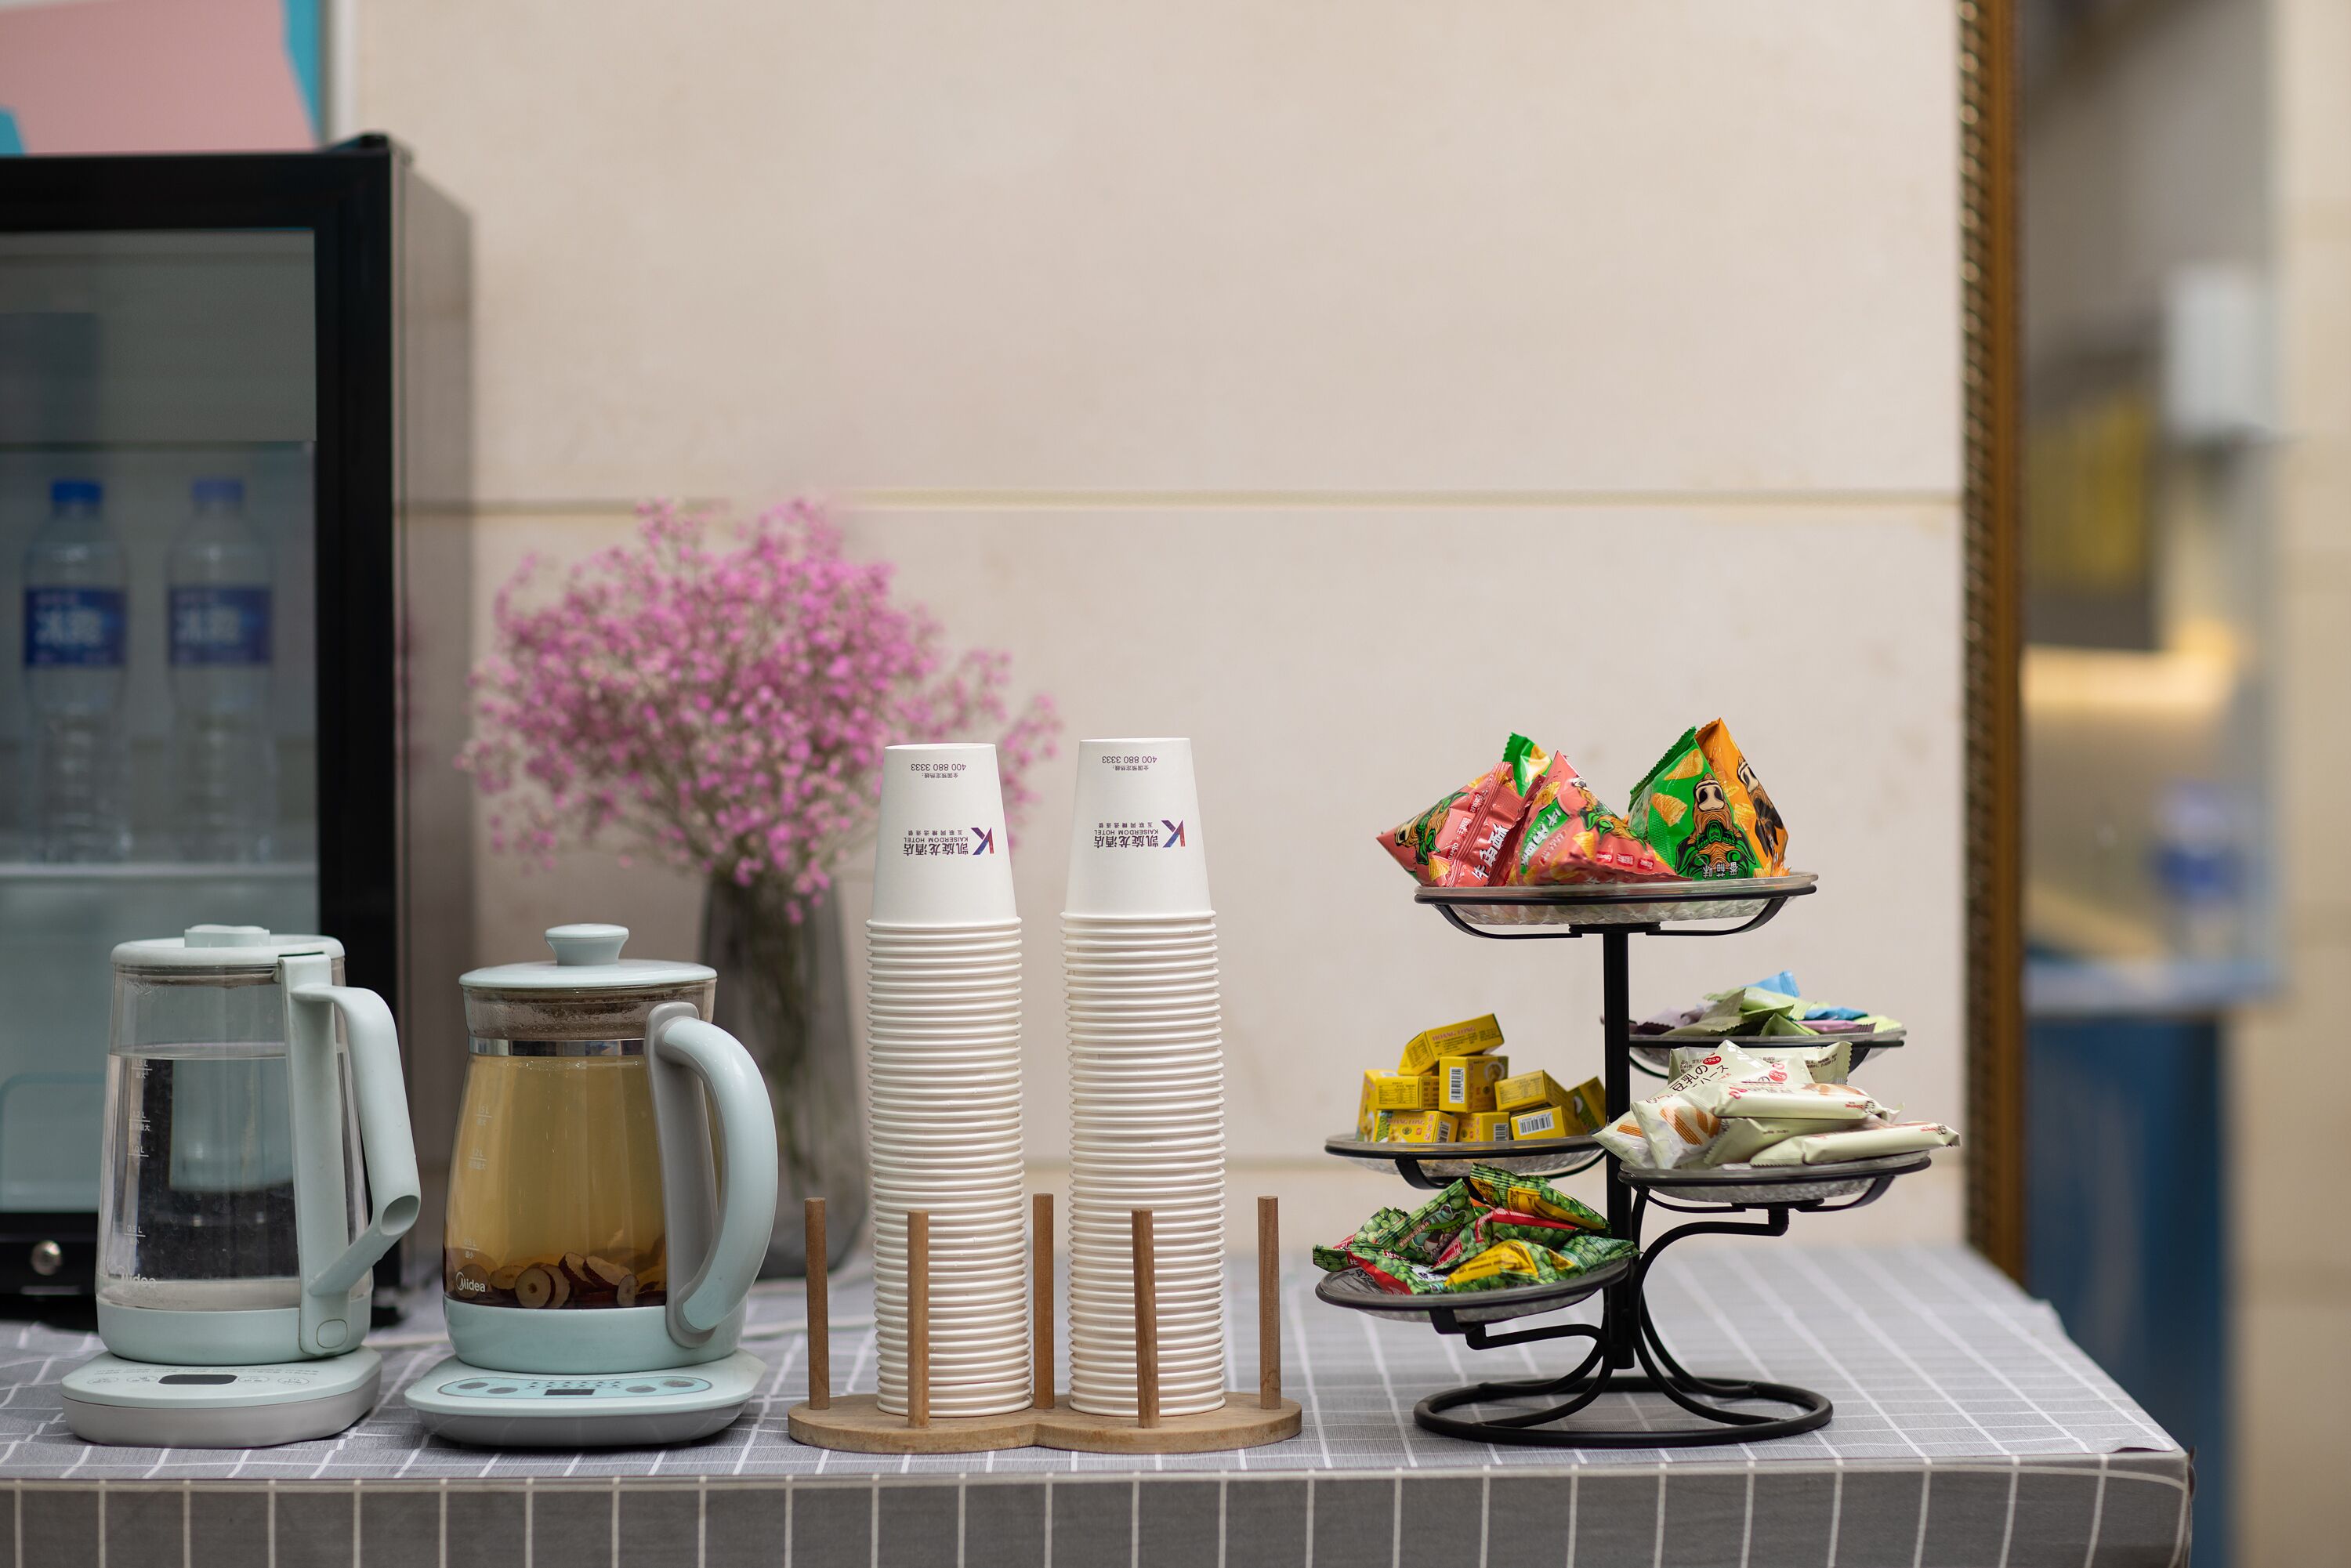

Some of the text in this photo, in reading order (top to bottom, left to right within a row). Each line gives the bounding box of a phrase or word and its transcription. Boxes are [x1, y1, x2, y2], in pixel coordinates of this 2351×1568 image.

[903, 842, 969, 856] 凯旋龙酒店
[1093, 835, 1159, 849] 凯旋龙酒店
[1703, 861, 1738, 878] 番茄味
[1669, 1064, 1708, 1092] 豆乳の
[455, 1271, 486, 1292] Midea
